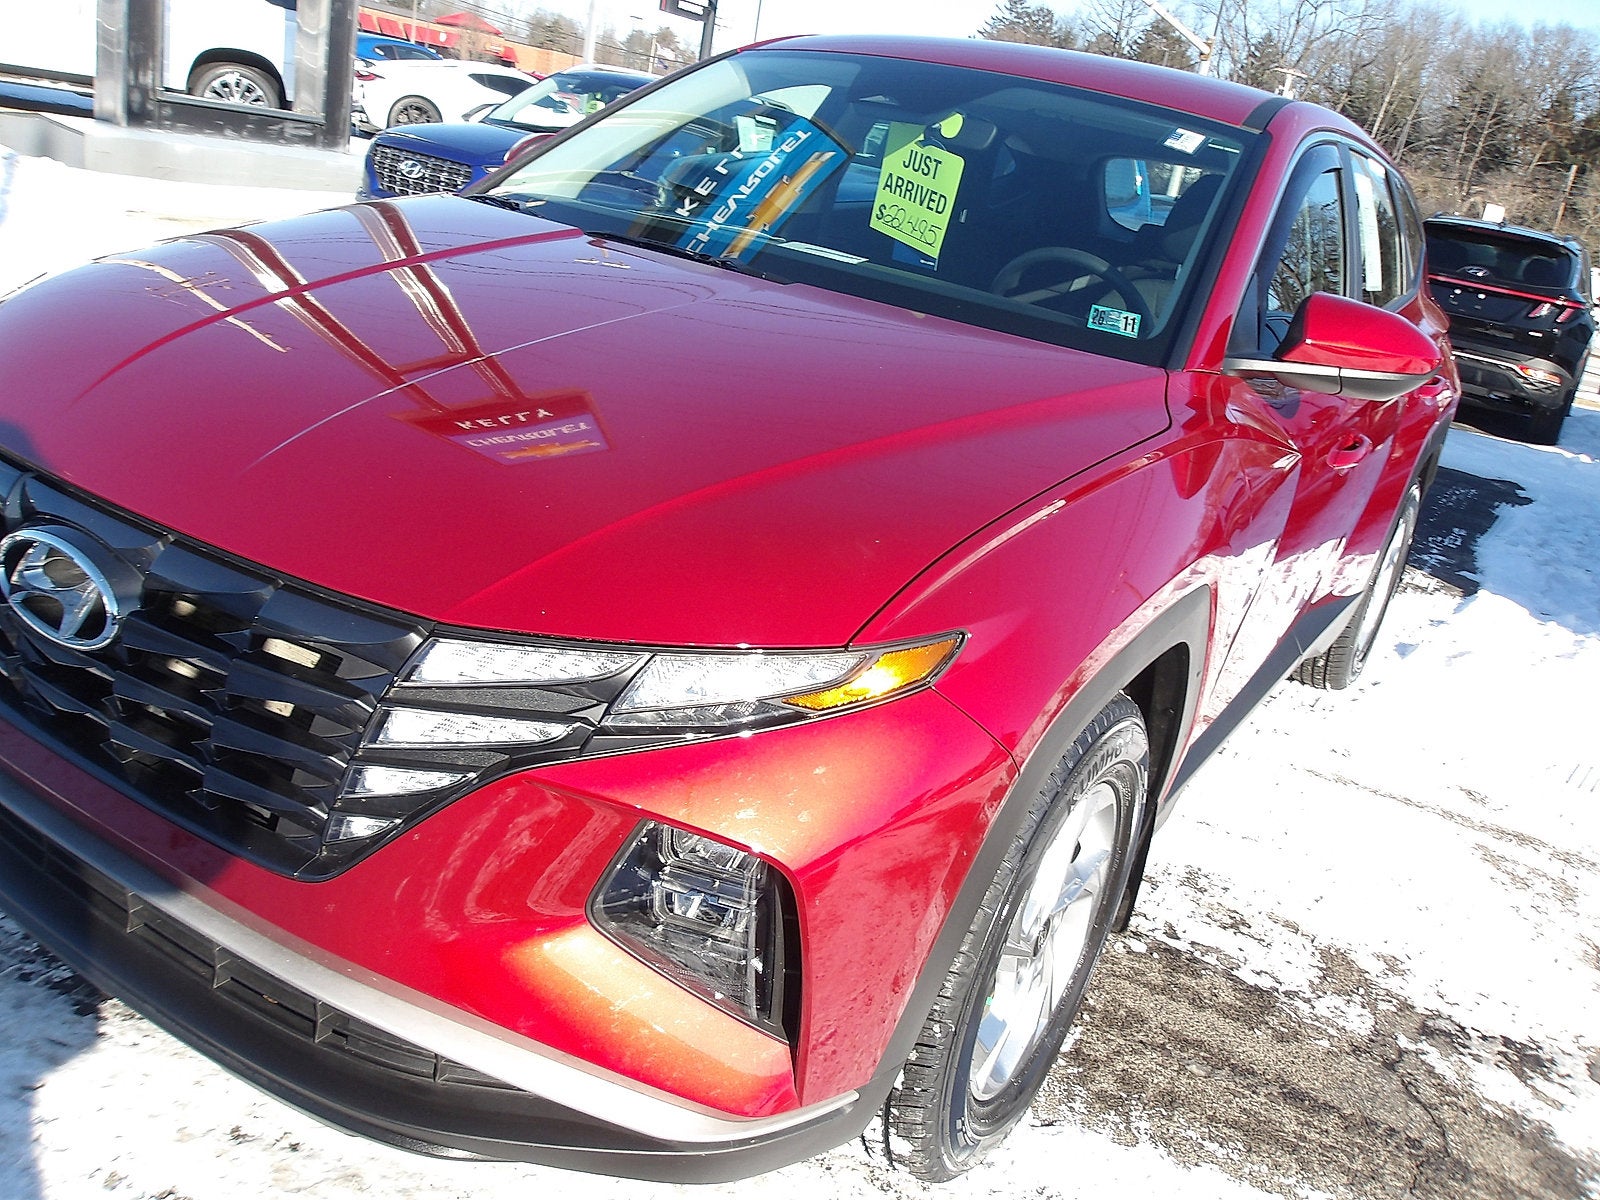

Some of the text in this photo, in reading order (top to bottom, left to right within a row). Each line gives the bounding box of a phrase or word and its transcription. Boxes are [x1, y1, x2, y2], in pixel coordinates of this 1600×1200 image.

[903, 149, 942, 180] JUST
[882, 172, 948, 215] ARRIVED
[1123, 315, 1137, 333] 11
